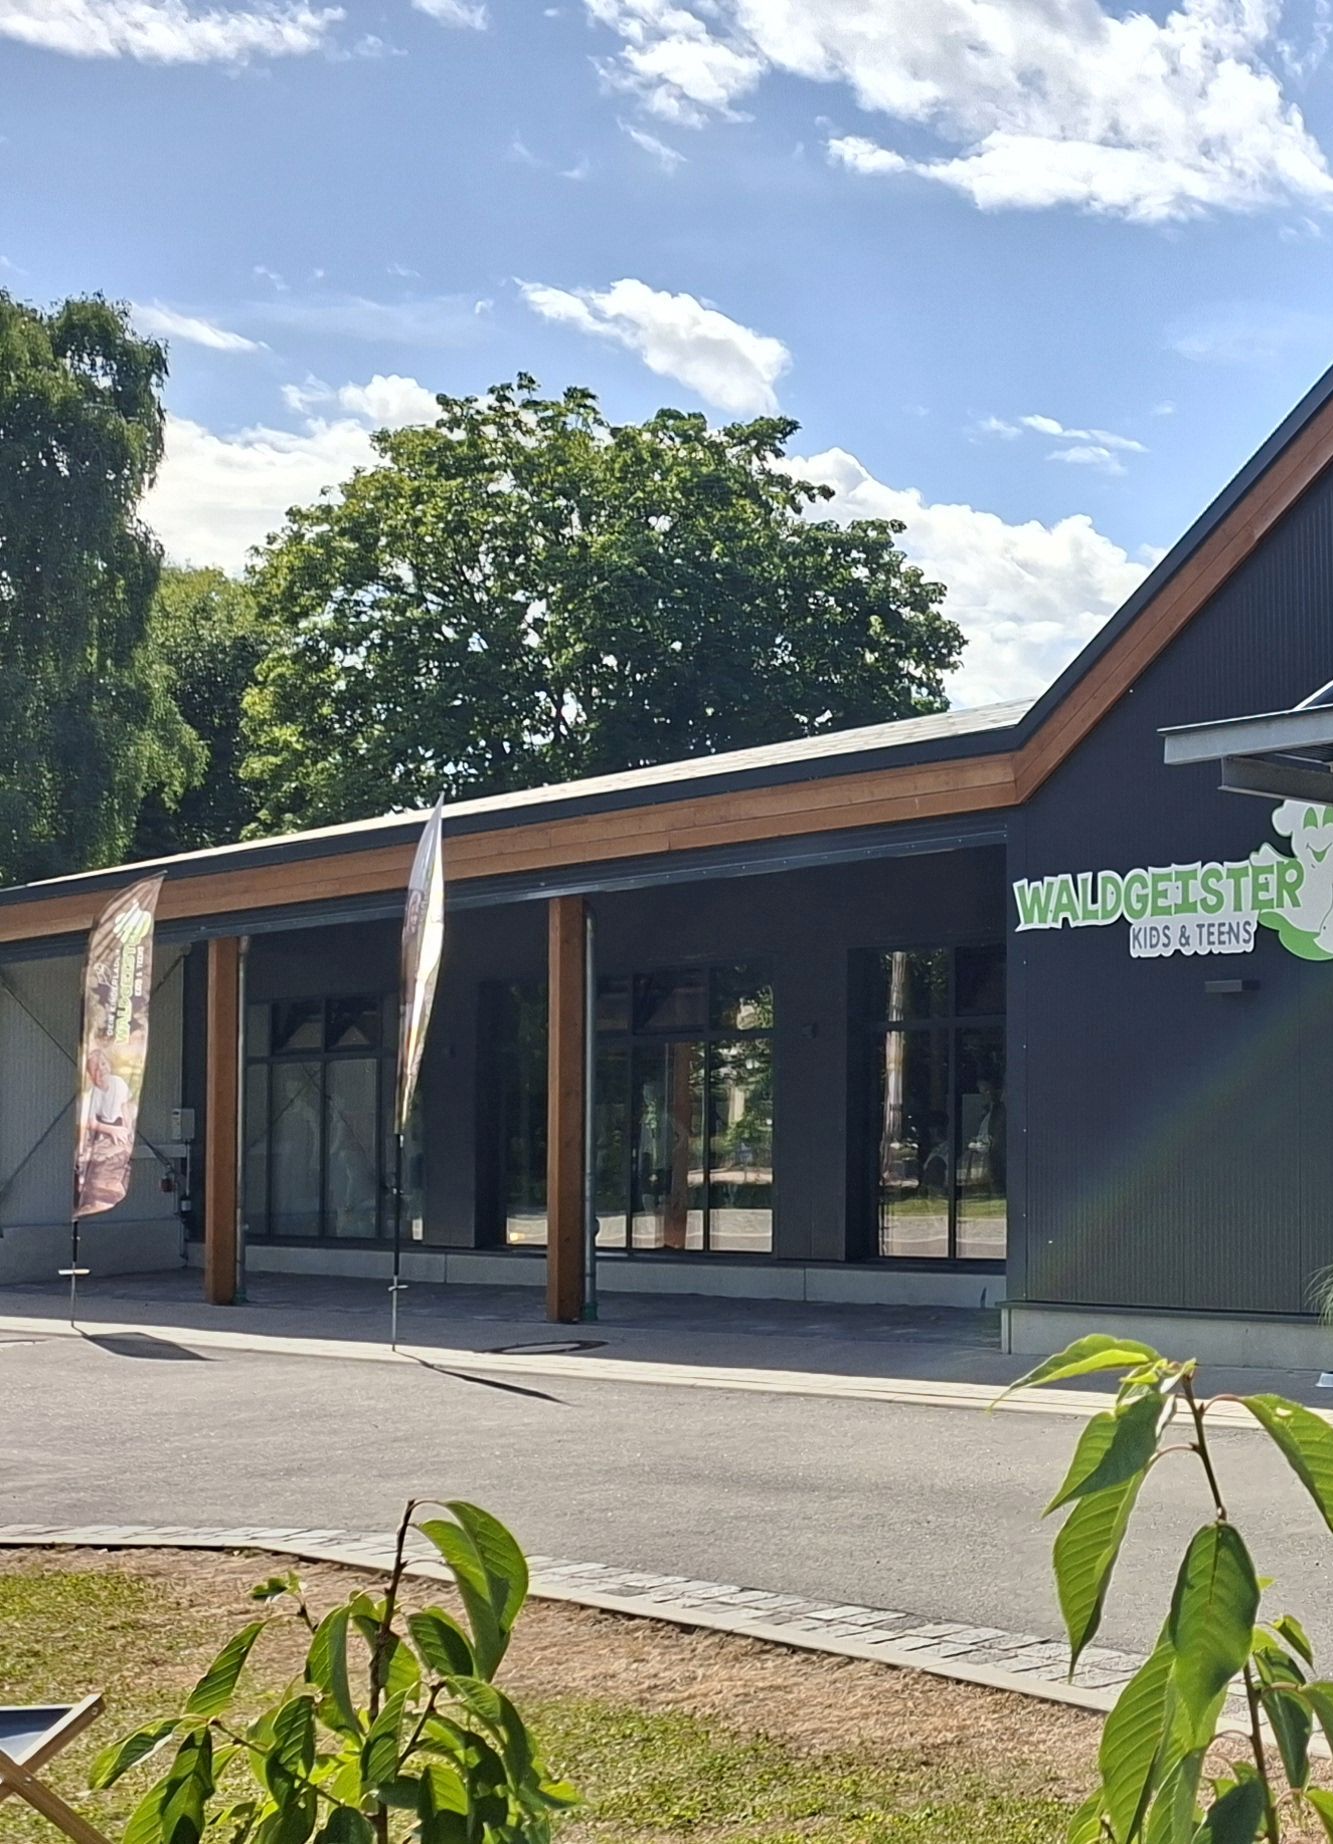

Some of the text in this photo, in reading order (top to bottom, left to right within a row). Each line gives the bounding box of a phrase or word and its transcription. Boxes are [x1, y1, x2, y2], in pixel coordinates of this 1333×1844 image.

[1016, 857, 1303, 925] WALDGEISTER
[1132, 919, 1253, 951] KIDS & TEENS
